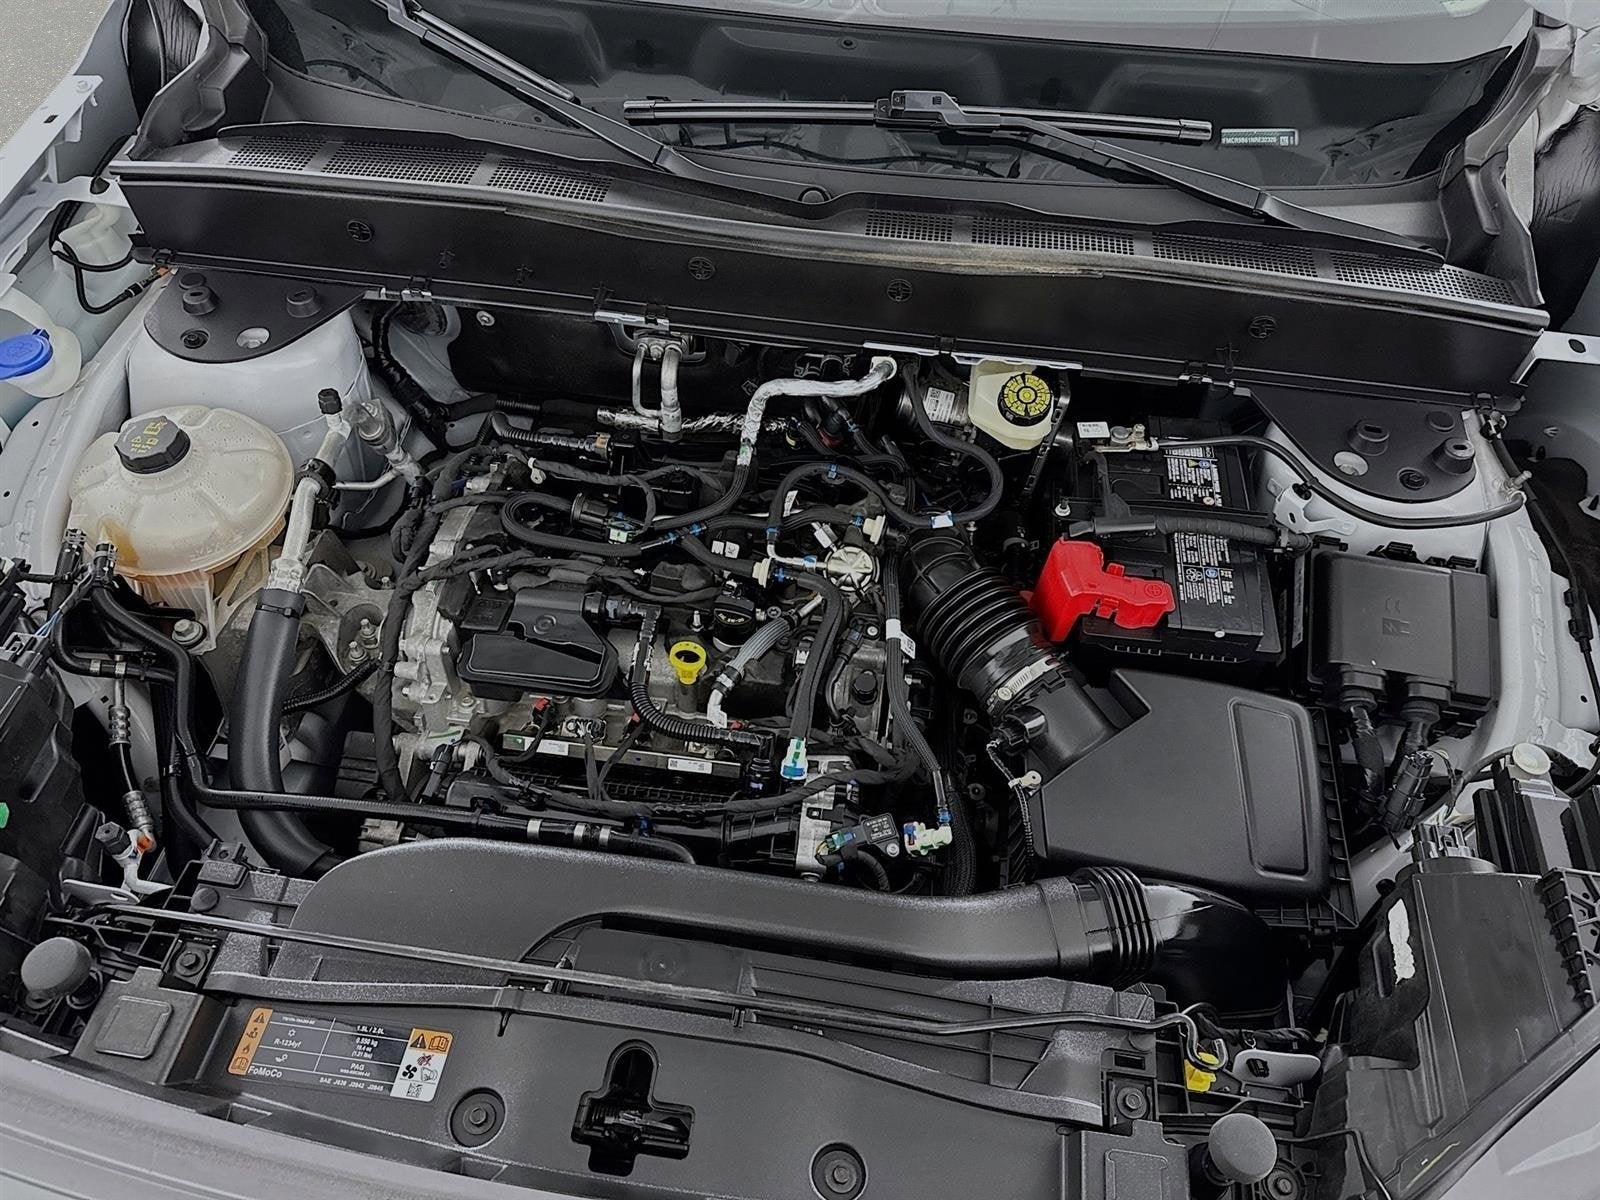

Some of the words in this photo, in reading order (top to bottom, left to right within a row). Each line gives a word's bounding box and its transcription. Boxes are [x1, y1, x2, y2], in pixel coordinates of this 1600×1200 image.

[274, 1038, 302, 1049] R-1234yf
[248, 1065, 283, 1078] FoMoCo
[350, 1062, 365, 1070] PAG
